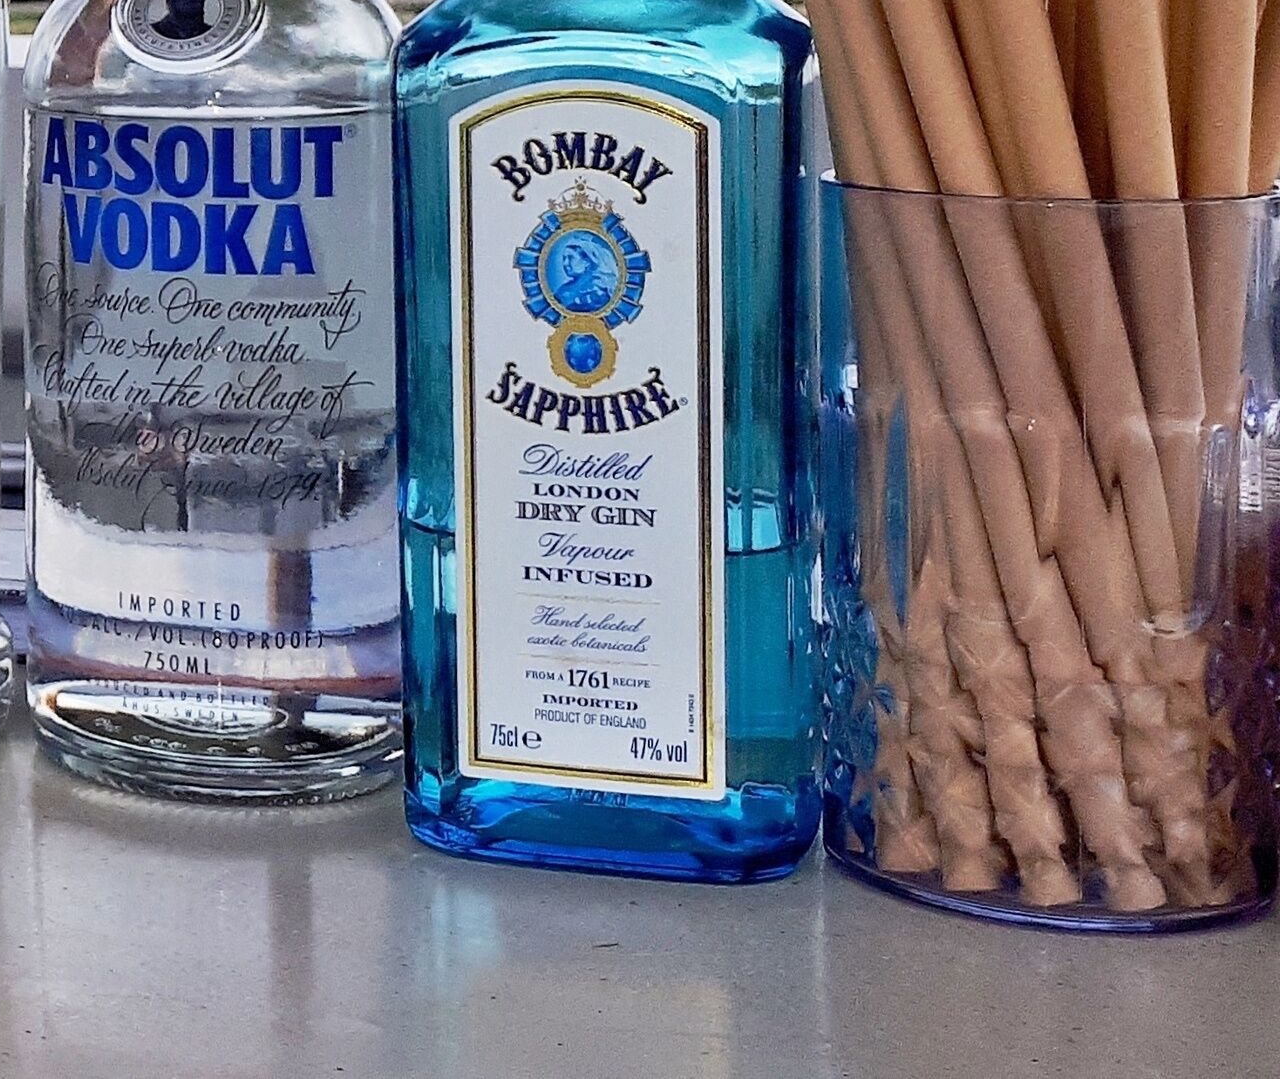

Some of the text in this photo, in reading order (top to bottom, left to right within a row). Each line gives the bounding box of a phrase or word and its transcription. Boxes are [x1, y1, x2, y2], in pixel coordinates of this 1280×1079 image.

[43, 117, 342, 199] ABSOLUT
[490, 131, 673, 205] BOMBAY
[63, 193, 316, 276] VODKA
[158, 277, 223, 324] One
[65, 313, 128, 356] One
[124, 380, 152, 406] in
[151, 364, 210, 409] the
[215, 365, 320, 433] village
[320, 371, 376, 439] of
[485, 362, 679, 435] SAPPHIRE
[518, 443, 655, 482] Distilled
[533, 483, 640, 501] LONDON
[515, 500, 658, 529] DRY GIN
[538, 532, 634, 566] Vapour
[521, 565, 653, 590] INFUSED
[118, 591, 241, 621] IMPORTED
[530, 604, 647, 634] Hand selected
[527, 632, 651, 654] exotic botanicals
[526, 670, 555, 681] FROM
[568, 669, 610, 689] 1761
[612, 677, 651, 689] RECIPE
[543, 693, 638, 711] IMPORTED
[534, 708, 647, 730] PRODUCT OF ENGLAND
[489, 723, 519, 748] 75cl
[630, 737, 688, 763] 47% vol
